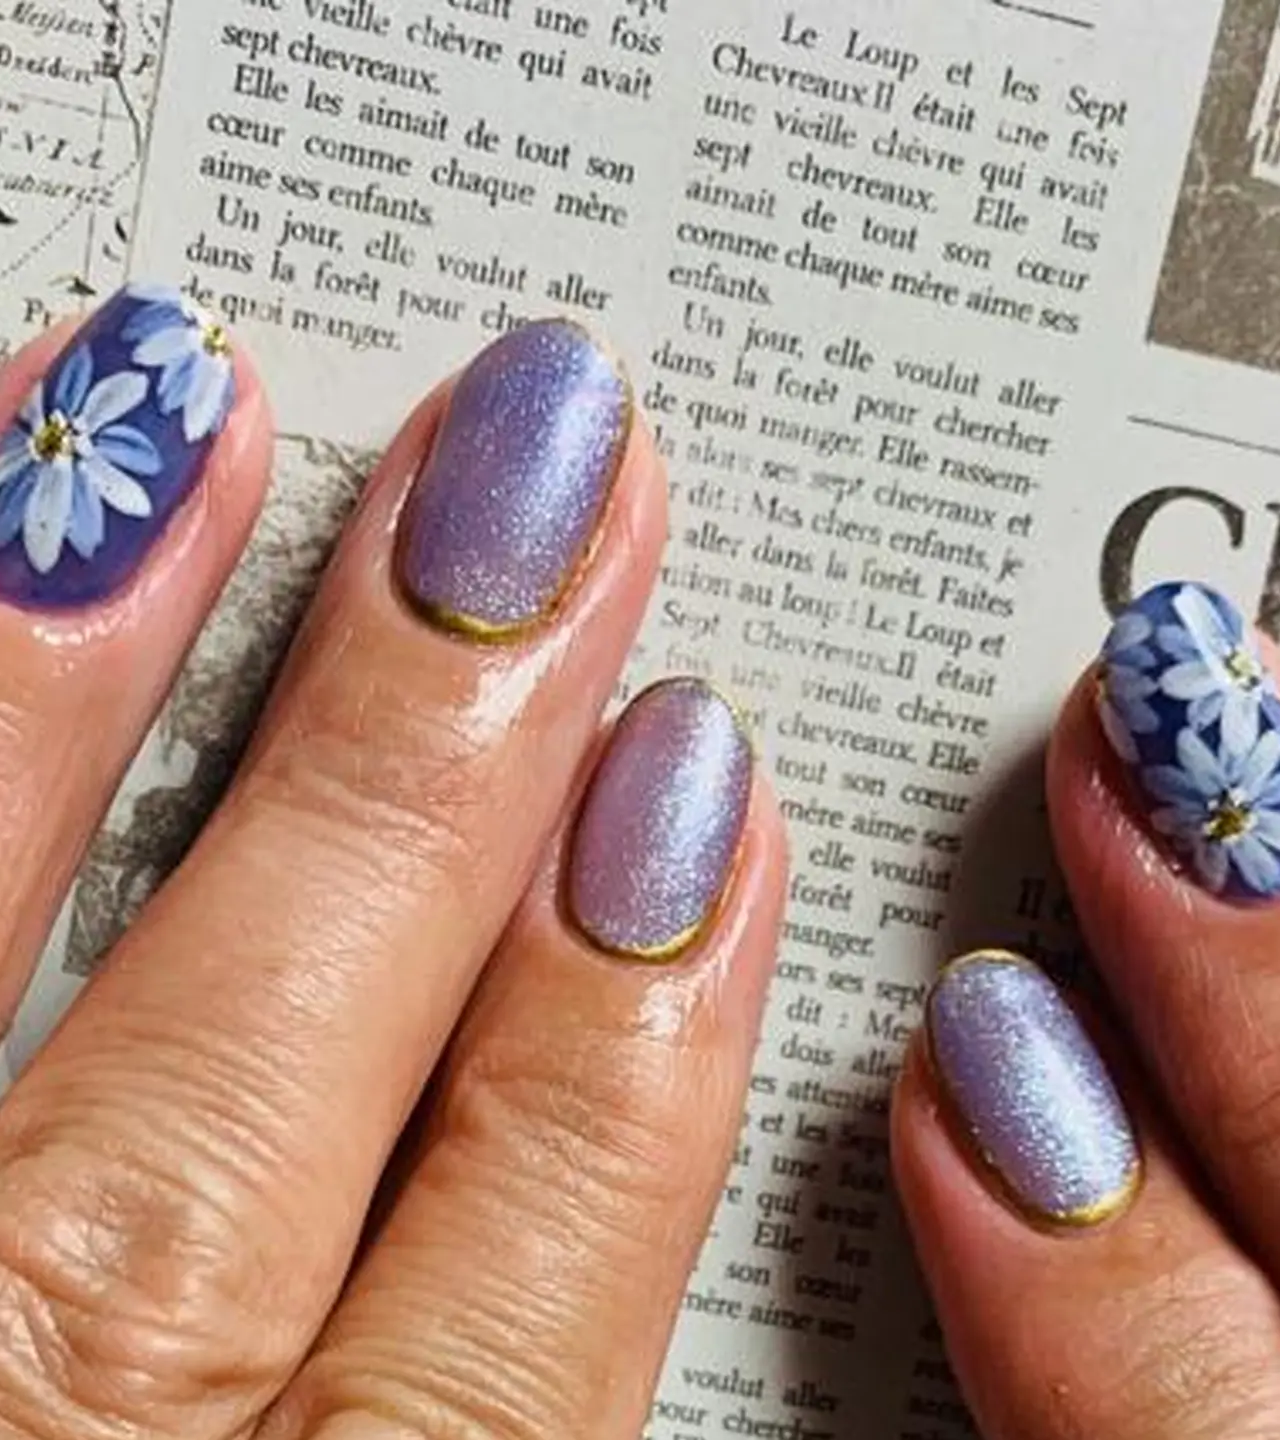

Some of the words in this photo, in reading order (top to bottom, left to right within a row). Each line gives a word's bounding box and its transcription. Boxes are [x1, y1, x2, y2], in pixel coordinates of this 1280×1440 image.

[221, 22, 278, 59] sept
[288, 35, 442, 97] chevreaux.
[406, 20, 502, 65] chèvre
[517, 46, 565, 83] qui
[581, 63, 652, 101] avait
[781, 14, 819, 49] Le
[844, 28, 919, 82] Loup
[946, 59, 973, 88] et
[1002, 66, 1039, 103] les
[1066, 85, 1127, 129] Sept
[233, 65, 289, 101] Elle
[304, 81, 341, 116] les
[358, 98, 448, 142] aimait
[464, 125, 500, 155] de
[516, 133, 571, 171] tout
[586, 155, 634, 185] son
[704, 93, 756, 125] une
[774, 106, 857, 150] vieille
[871, 130, 964, 176] chèvre
[980, 156, 1025, 193] qui
[1039, 174, 1107, 211] avait
[199, 155, 271, 190] aime
[278, 171, 320, 201] ses
[206, 113, 285, 150] cœur
[304, 133, 412, 177] comme
[431, 158, 536, 208] chaque
[555, 188, 628, 228] mère
[693, 134, 750, 172] sept
[973, 196, 1029, 233] Elle
[1062, 217, 1099, 253] les
[217, 197, 259, 232] Un
[365, 232, 416, 269] elle
[437, 254, 525, 293] voulut
[546, 276, 612, 313] aller
[686, 177, 776, 218] aimait
[801, 199, 837, 233] de
[862, 215, 918, 253] tout
[943, 240, 992, 270] son
[1016, 258, 1090, 294] cœur
[853, 393, 919, 424] pour
[933, 408, 1054, 458] chercher
[893, 357, 980, 398] voulut
[997, 382, 1062, 417] aller
[906, 610, 973, 659] Loup
[980, 631, 1005, 659] et
[937, 576, 1014, 618] Faites
[682, 1364, 766, 1400] voulut
